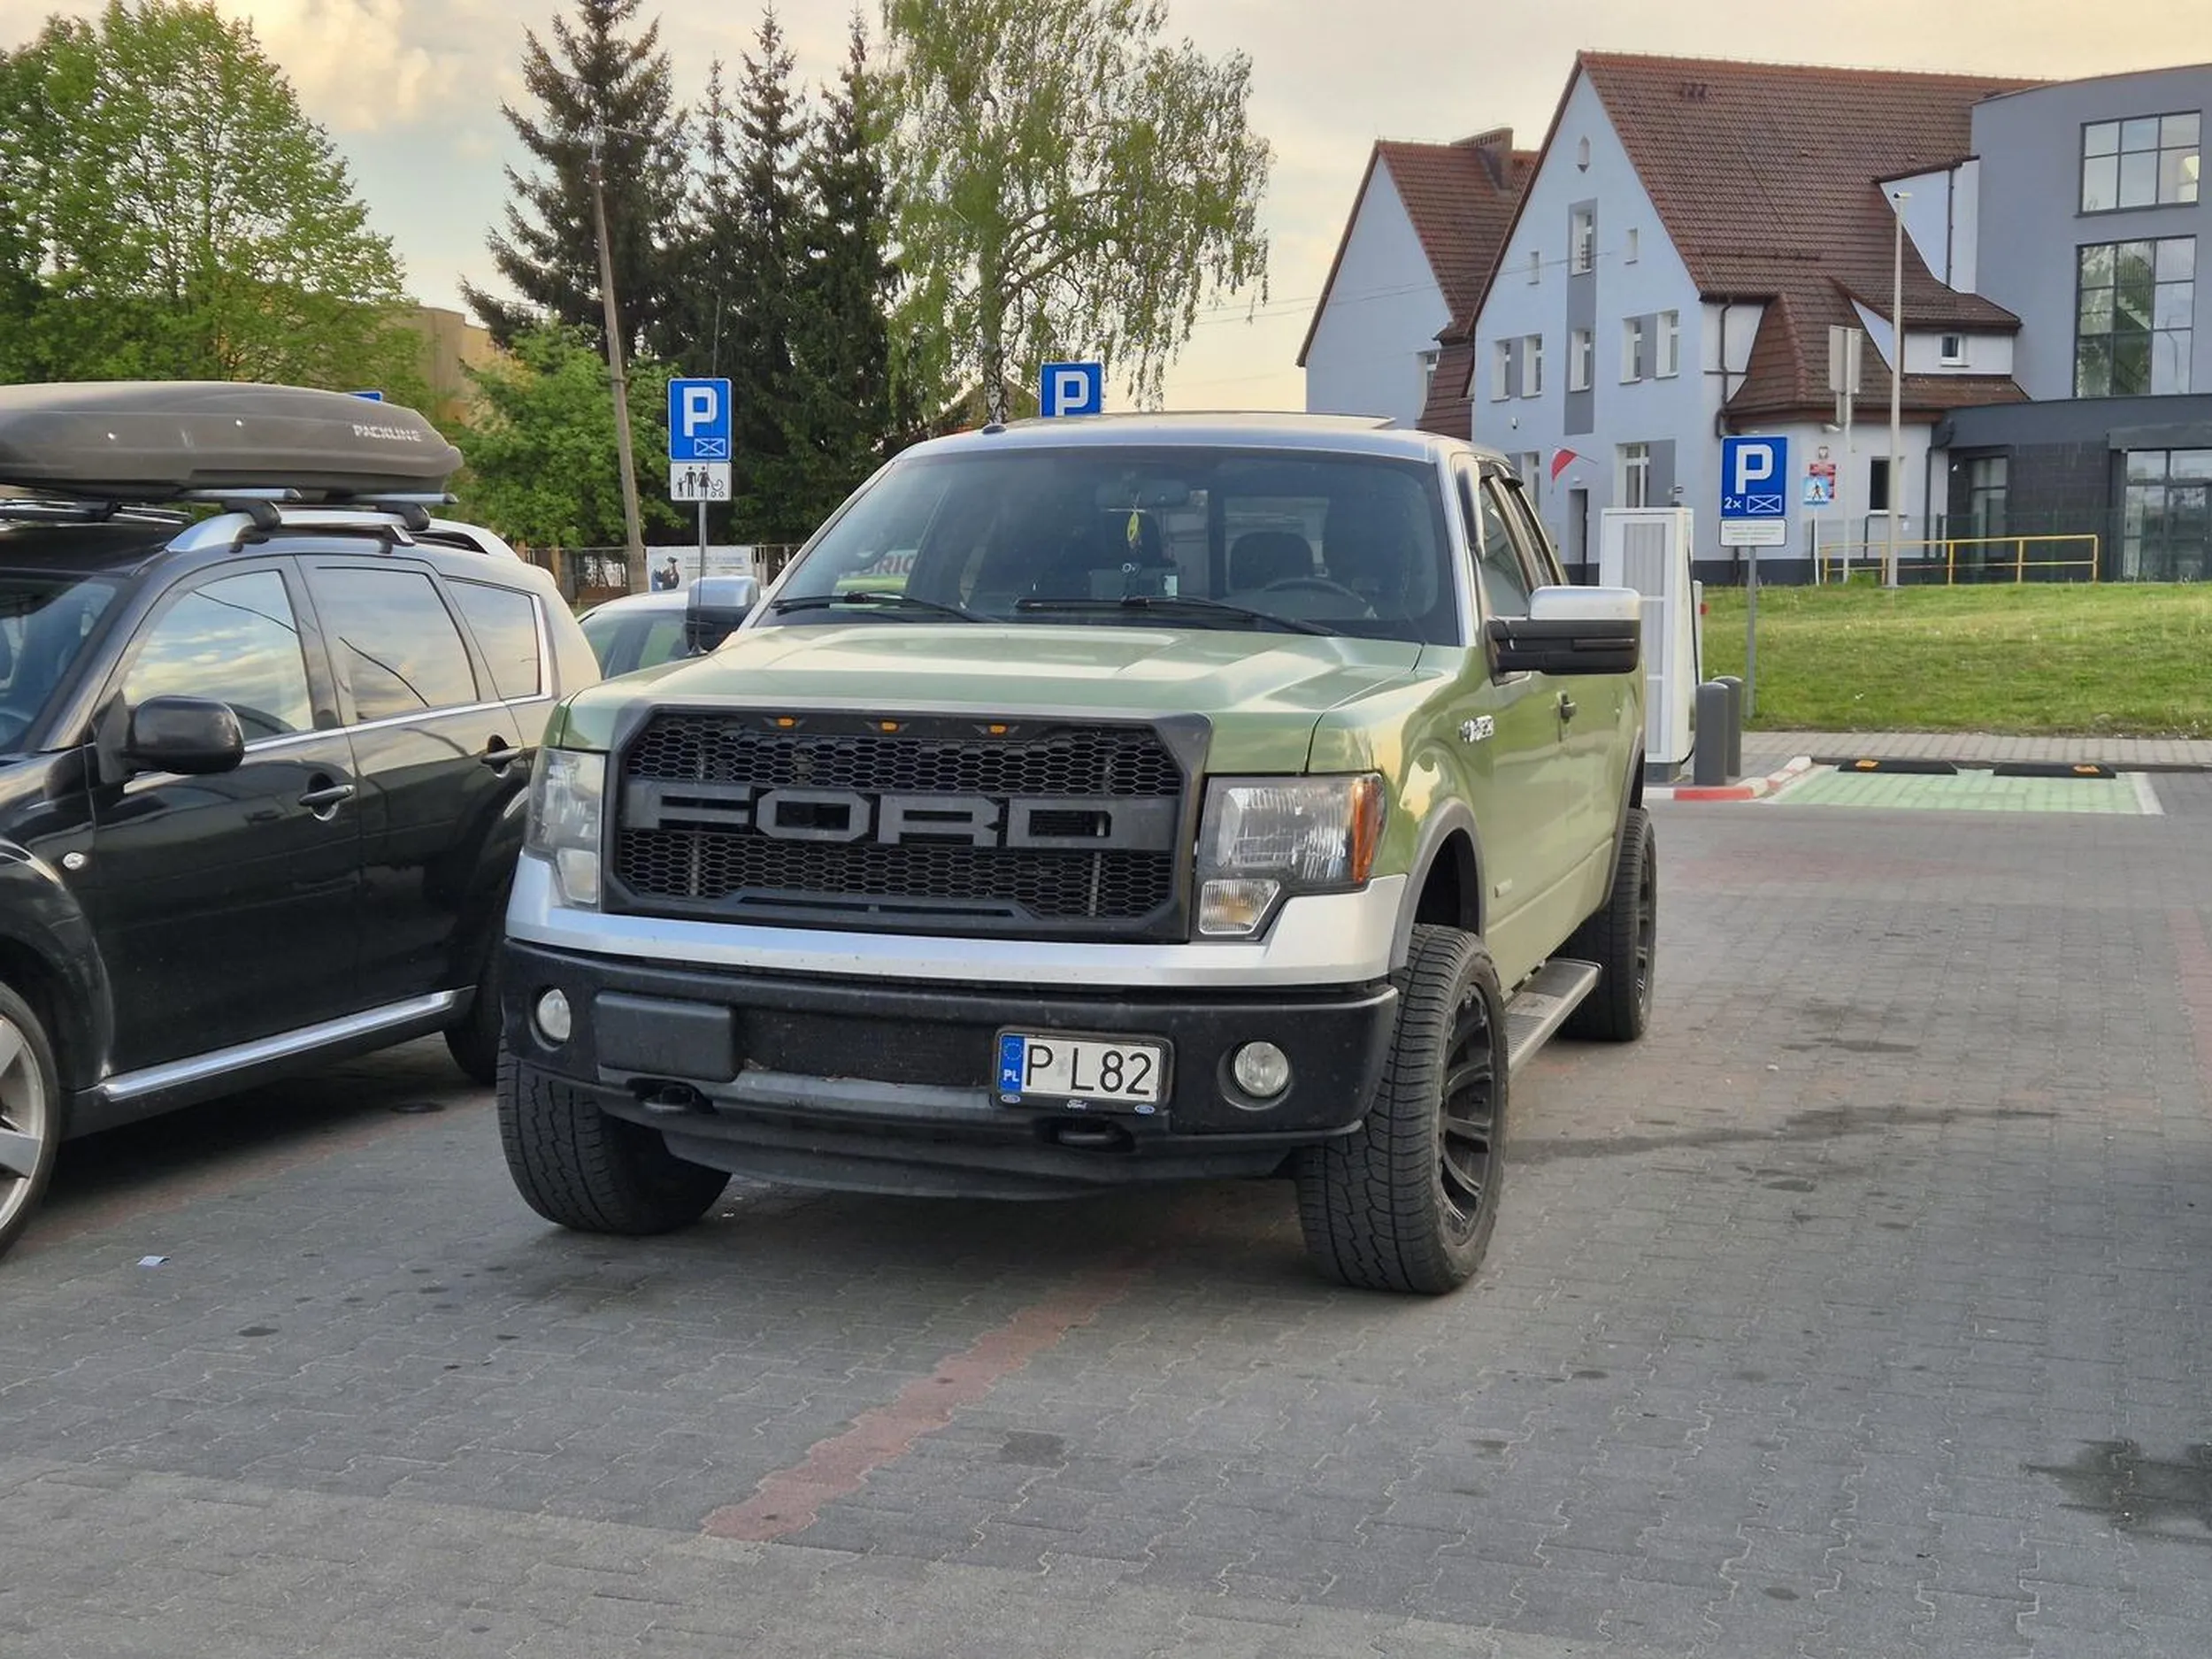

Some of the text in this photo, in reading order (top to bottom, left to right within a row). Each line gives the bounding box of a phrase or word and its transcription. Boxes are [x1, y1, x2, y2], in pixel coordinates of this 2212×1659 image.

[683, 386, 718, 437] P
[1056, 371, 1089, 417] P
[1735, 443, 1774, 495] P
[1724, 496, 1742, 510] 2x
[626, 780, 1133, 849] FORD
[1003, 1070, 1019, 1082] PL
[1025, 1044, 1152, 1095] P L82
